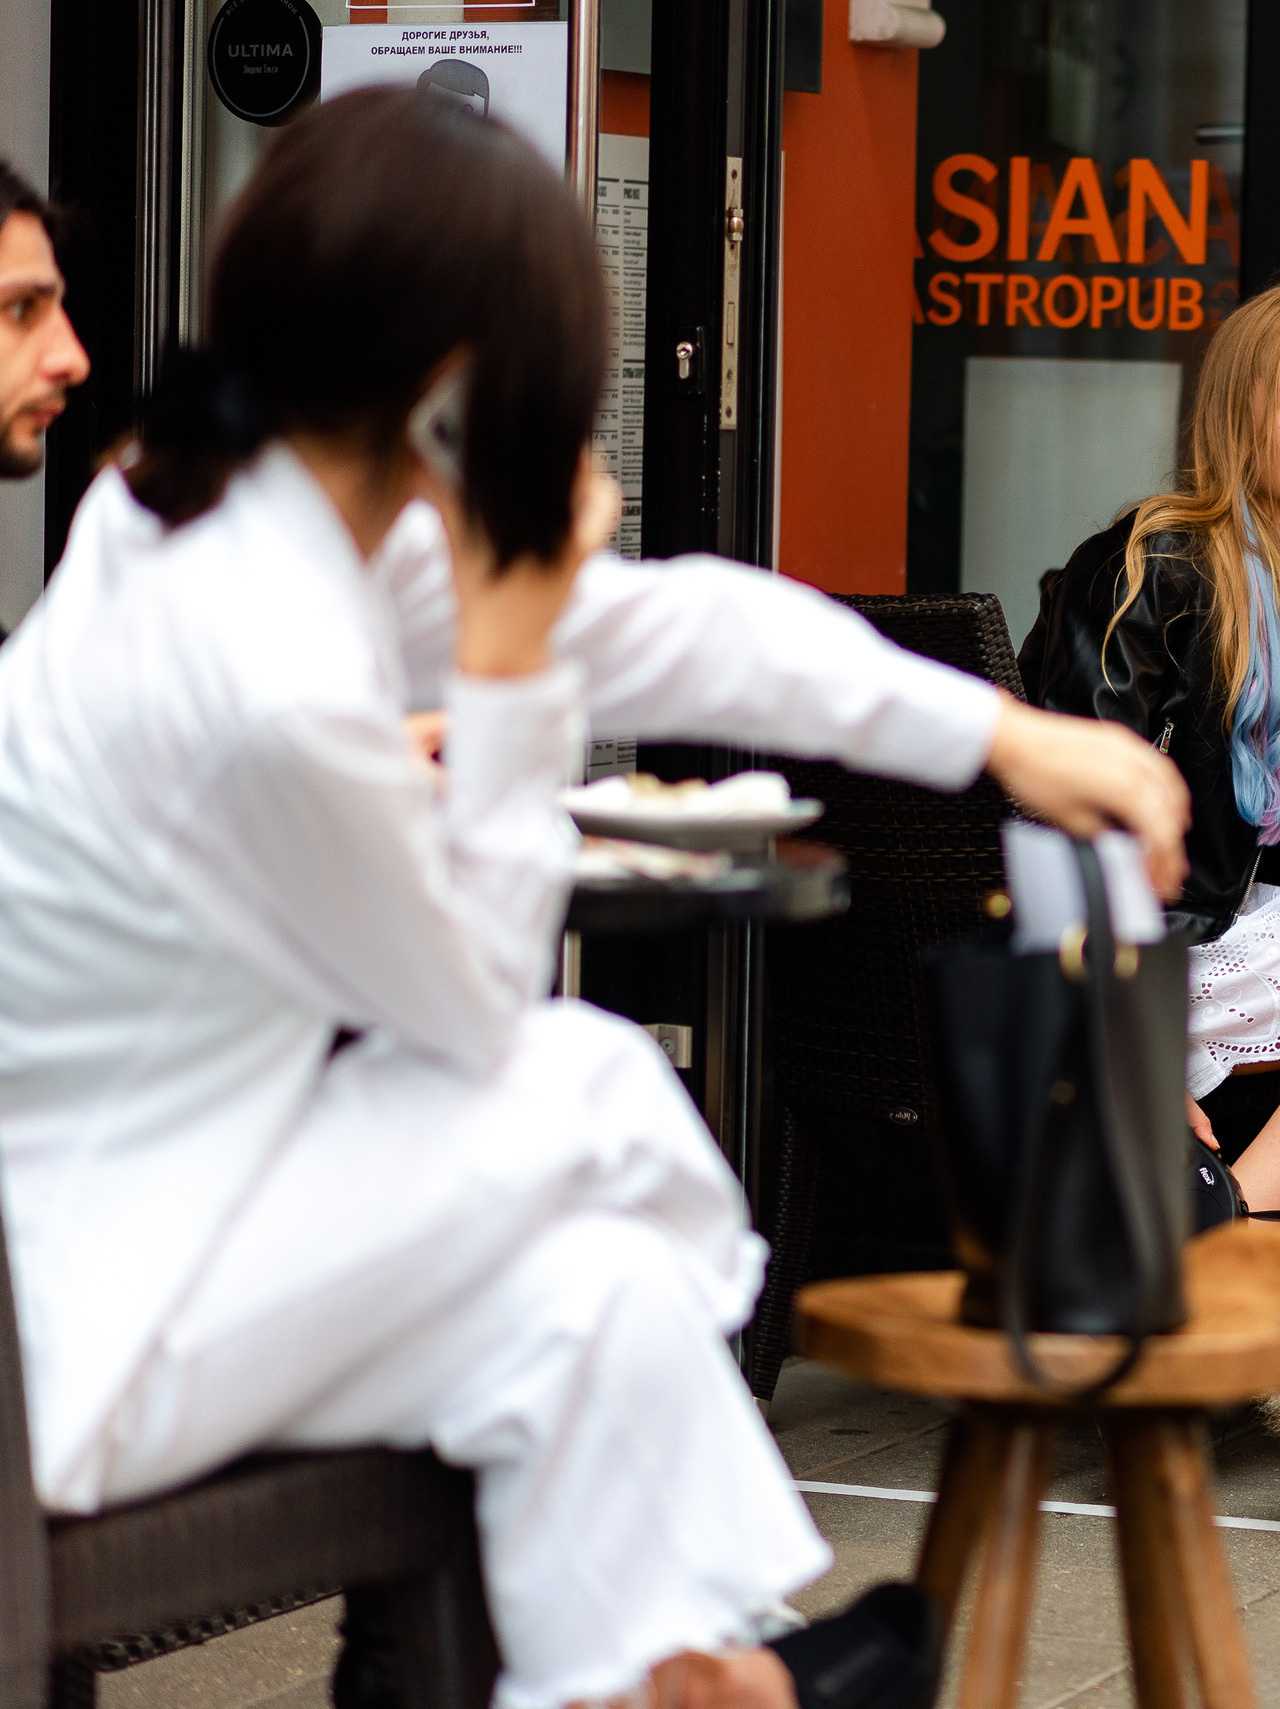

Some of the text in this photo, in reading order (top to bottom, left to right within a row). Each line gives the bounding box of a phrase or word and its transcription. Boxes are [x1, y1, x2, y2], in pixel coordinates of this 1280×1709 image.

[401, 30, 490, 41] ДОРОГИЕ ДРУЗЬЯ,
[228, 43, 294, 58] ULTIMA
[371, 44, 523, 56] ОБРАЩАЕМ ВАШЕ ВНИМАНИЕ!!!
[914, 153, 1209, 265] SIAN
